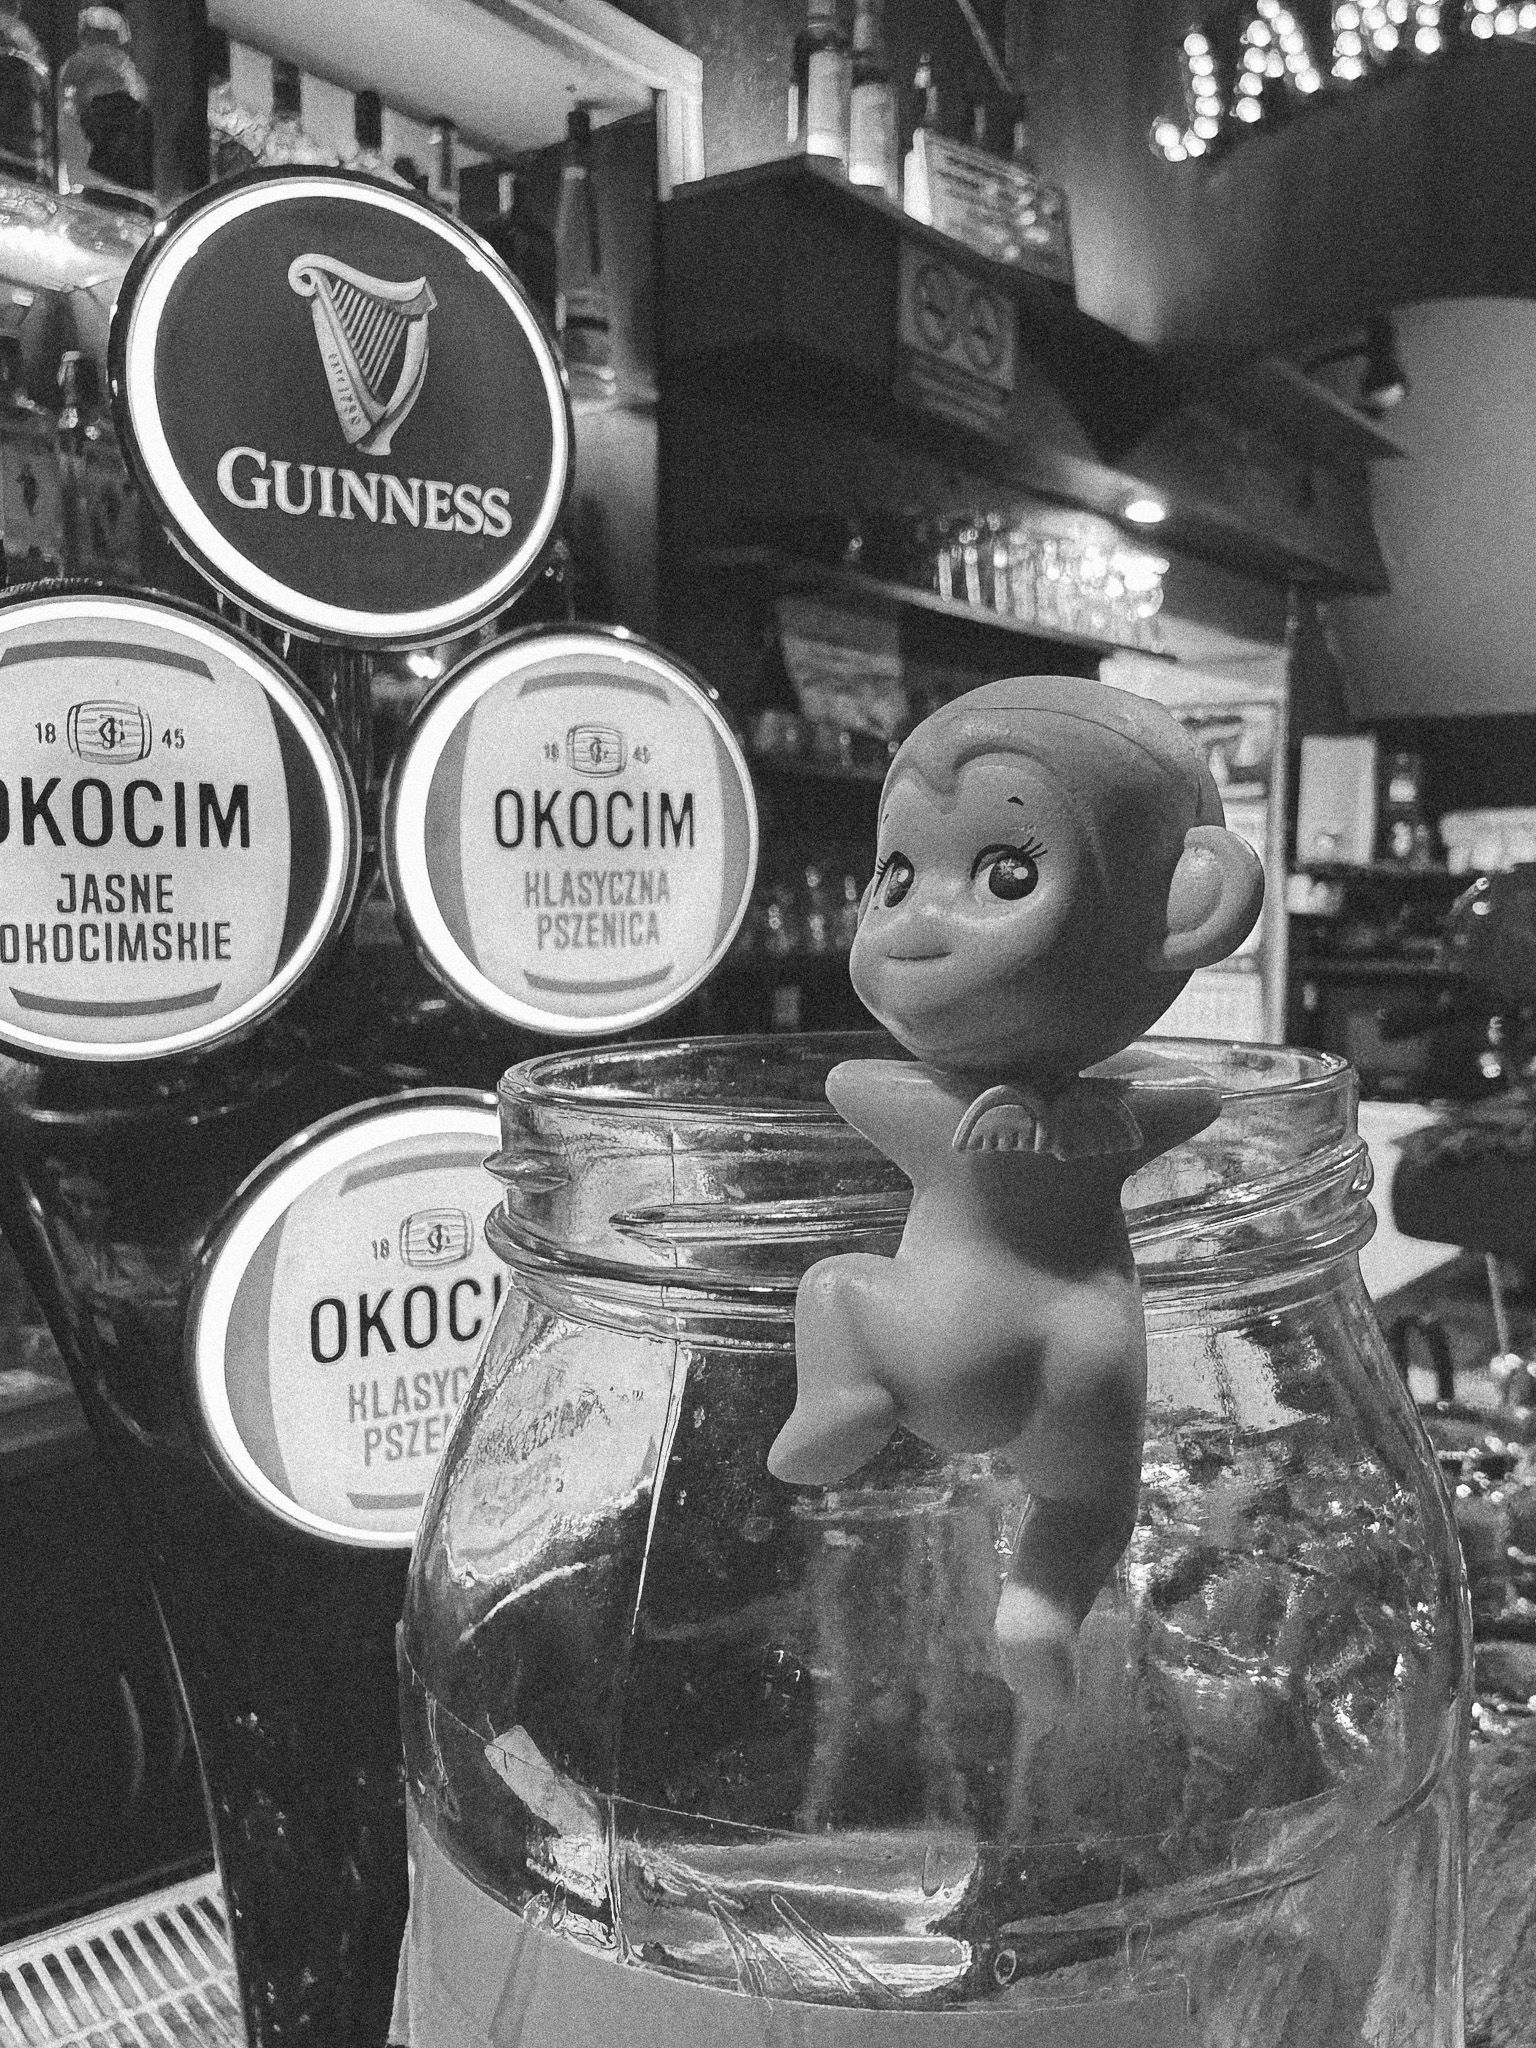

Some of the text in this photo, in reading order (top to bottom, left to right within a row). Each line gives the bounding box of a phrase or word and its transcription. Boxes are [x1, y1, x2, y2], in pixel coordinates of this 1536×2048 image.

[1149, 0, 1536, 162] JAM
[216, 446, 513, 537] GUINNESS
[35, 721, 57, 745] 18
[0, 776, 250, 849] KOCIM
[494, 788, 695, 849] OKOCIM
[56, 873, 174, 914] JASNE
[524, 869, 670, 908] KLASYCZNA
[0, 920, 232, 964] OKOCIMSKIE
[536, 910, 661, 951] PSZENICA
[371, 1237, 391, 1260] 18
